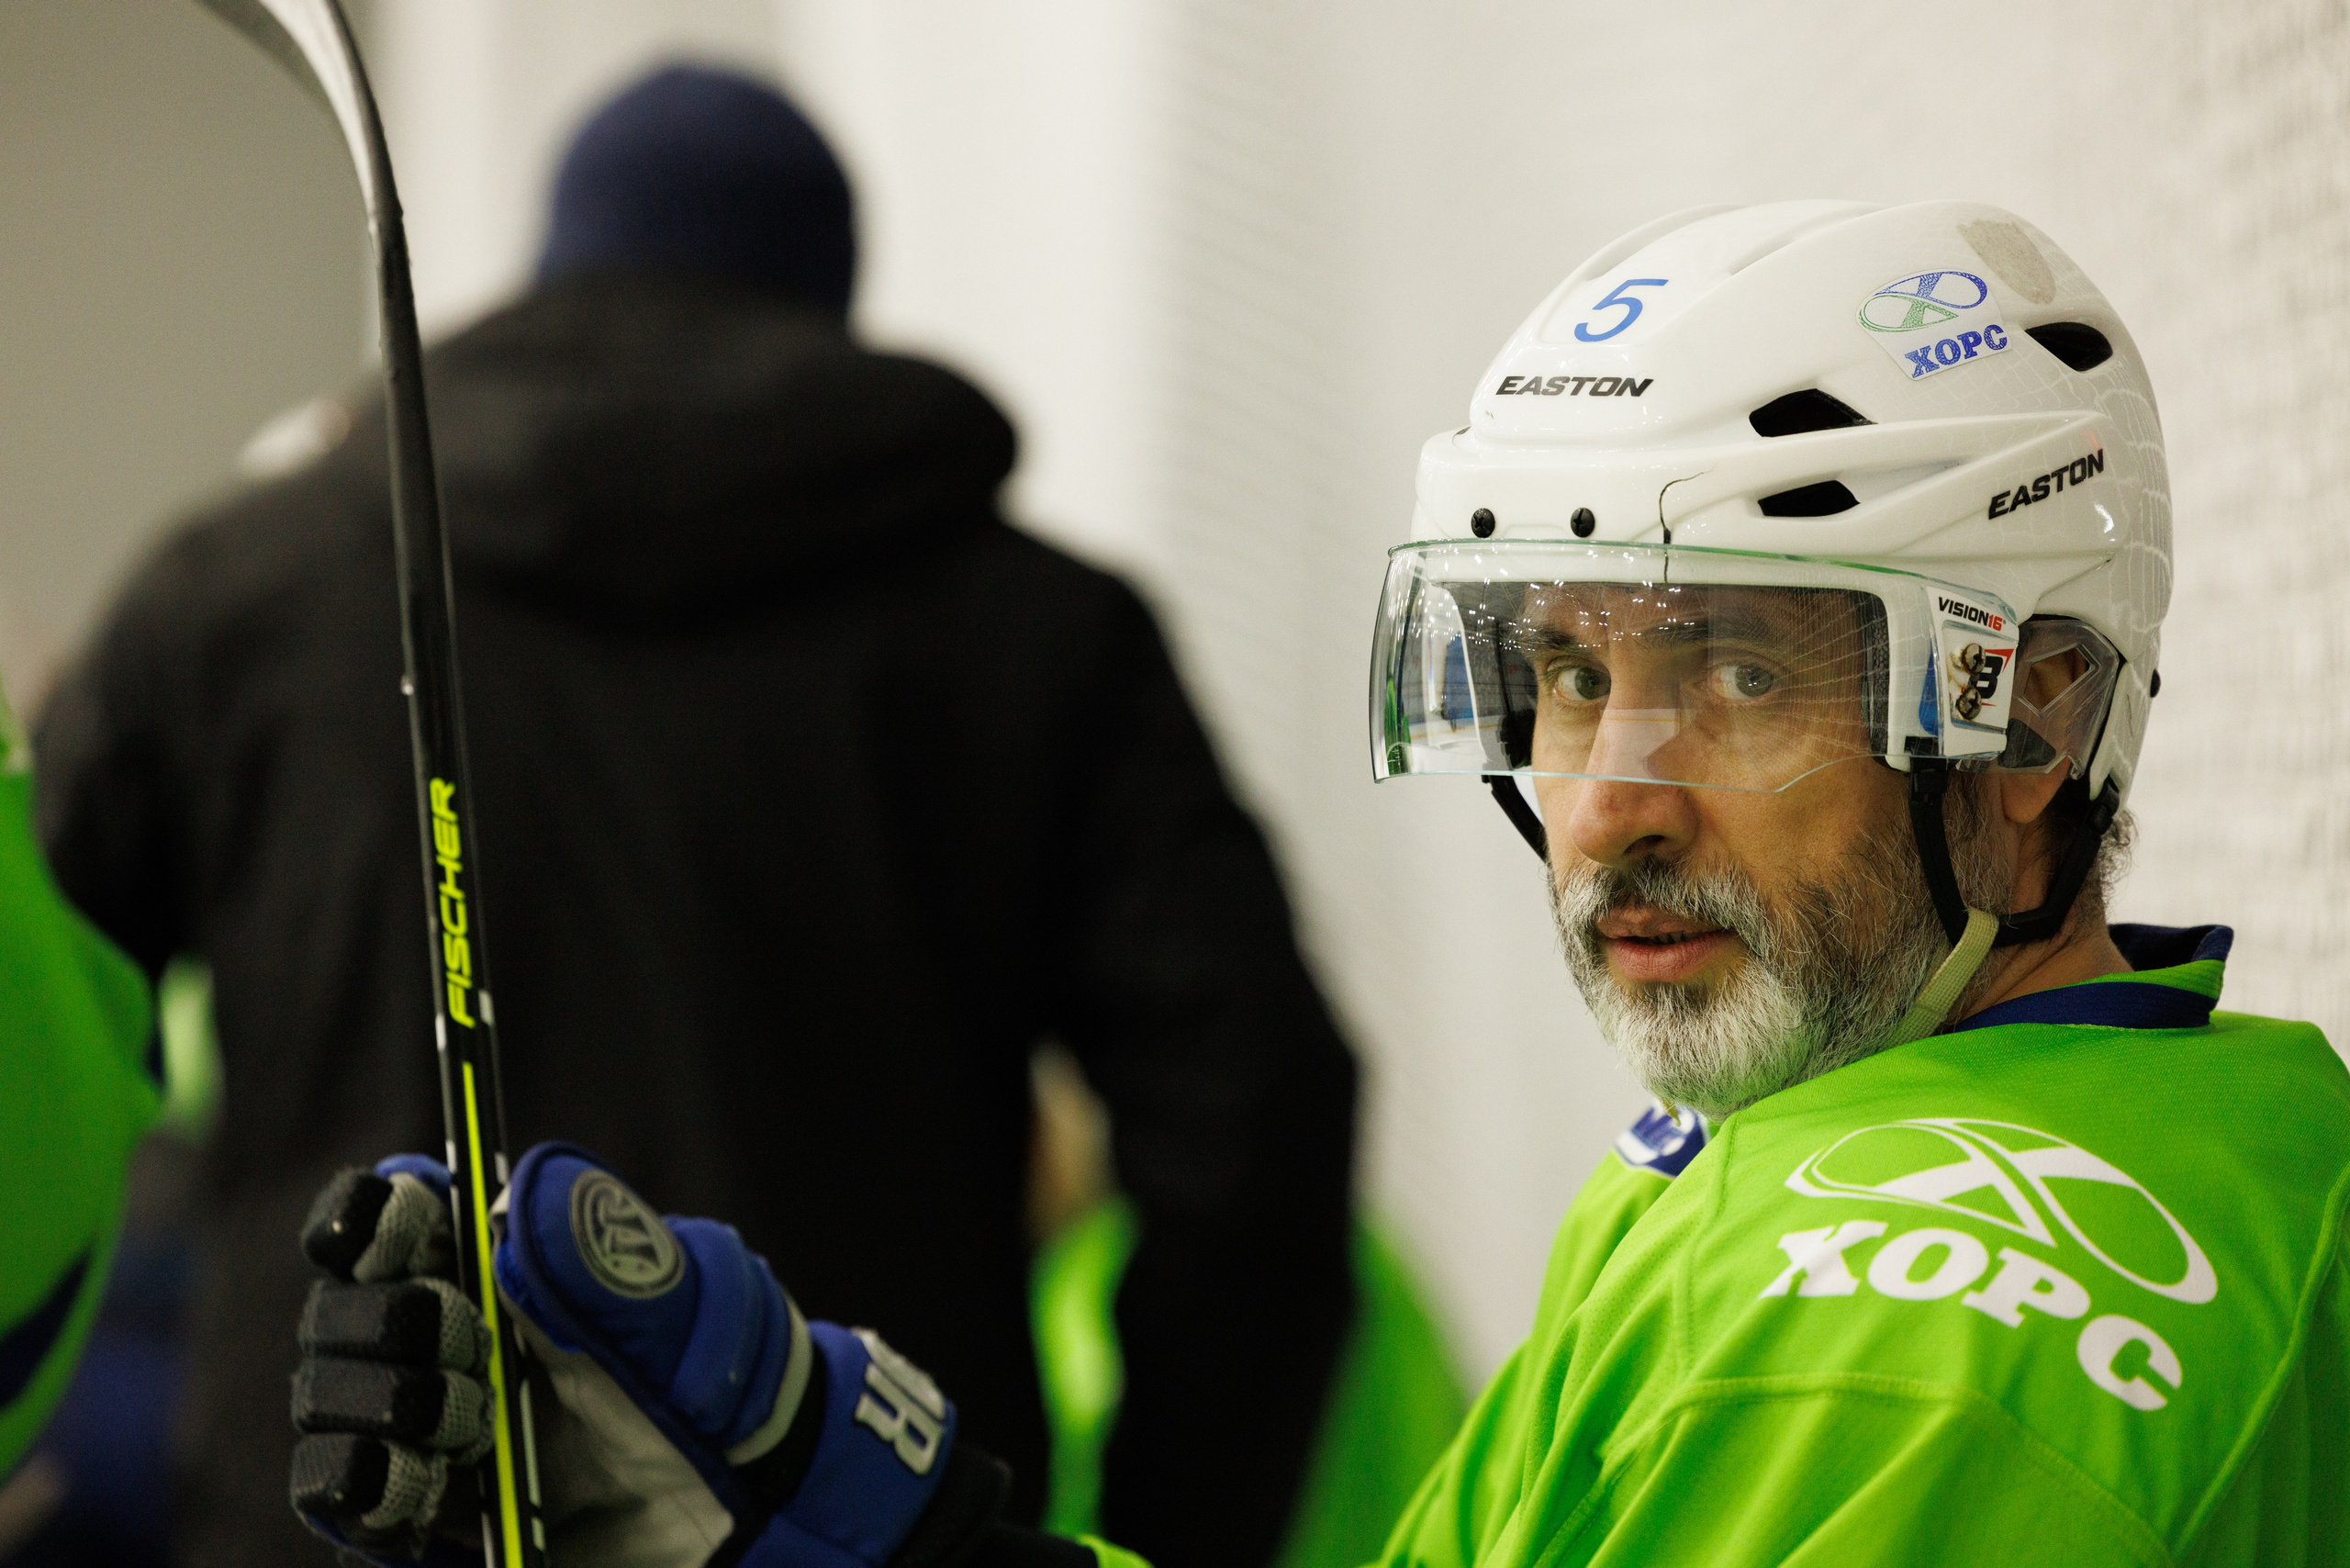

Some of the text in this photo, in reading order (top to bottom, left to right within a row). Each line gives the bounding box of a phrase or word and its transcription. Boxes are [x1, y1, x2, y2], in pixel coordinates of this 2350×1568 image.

[1574, 278, 1669, 342] 5
[1905, 324, 2008, 379] ХОРС
[1495, 375, 1654, 397] EASTON
[1988, 449, 2104, 520] EASTON
[430, 778, 476, 1029] FISCHER
[1757, 1220, 2183, 1411] ХОРС
